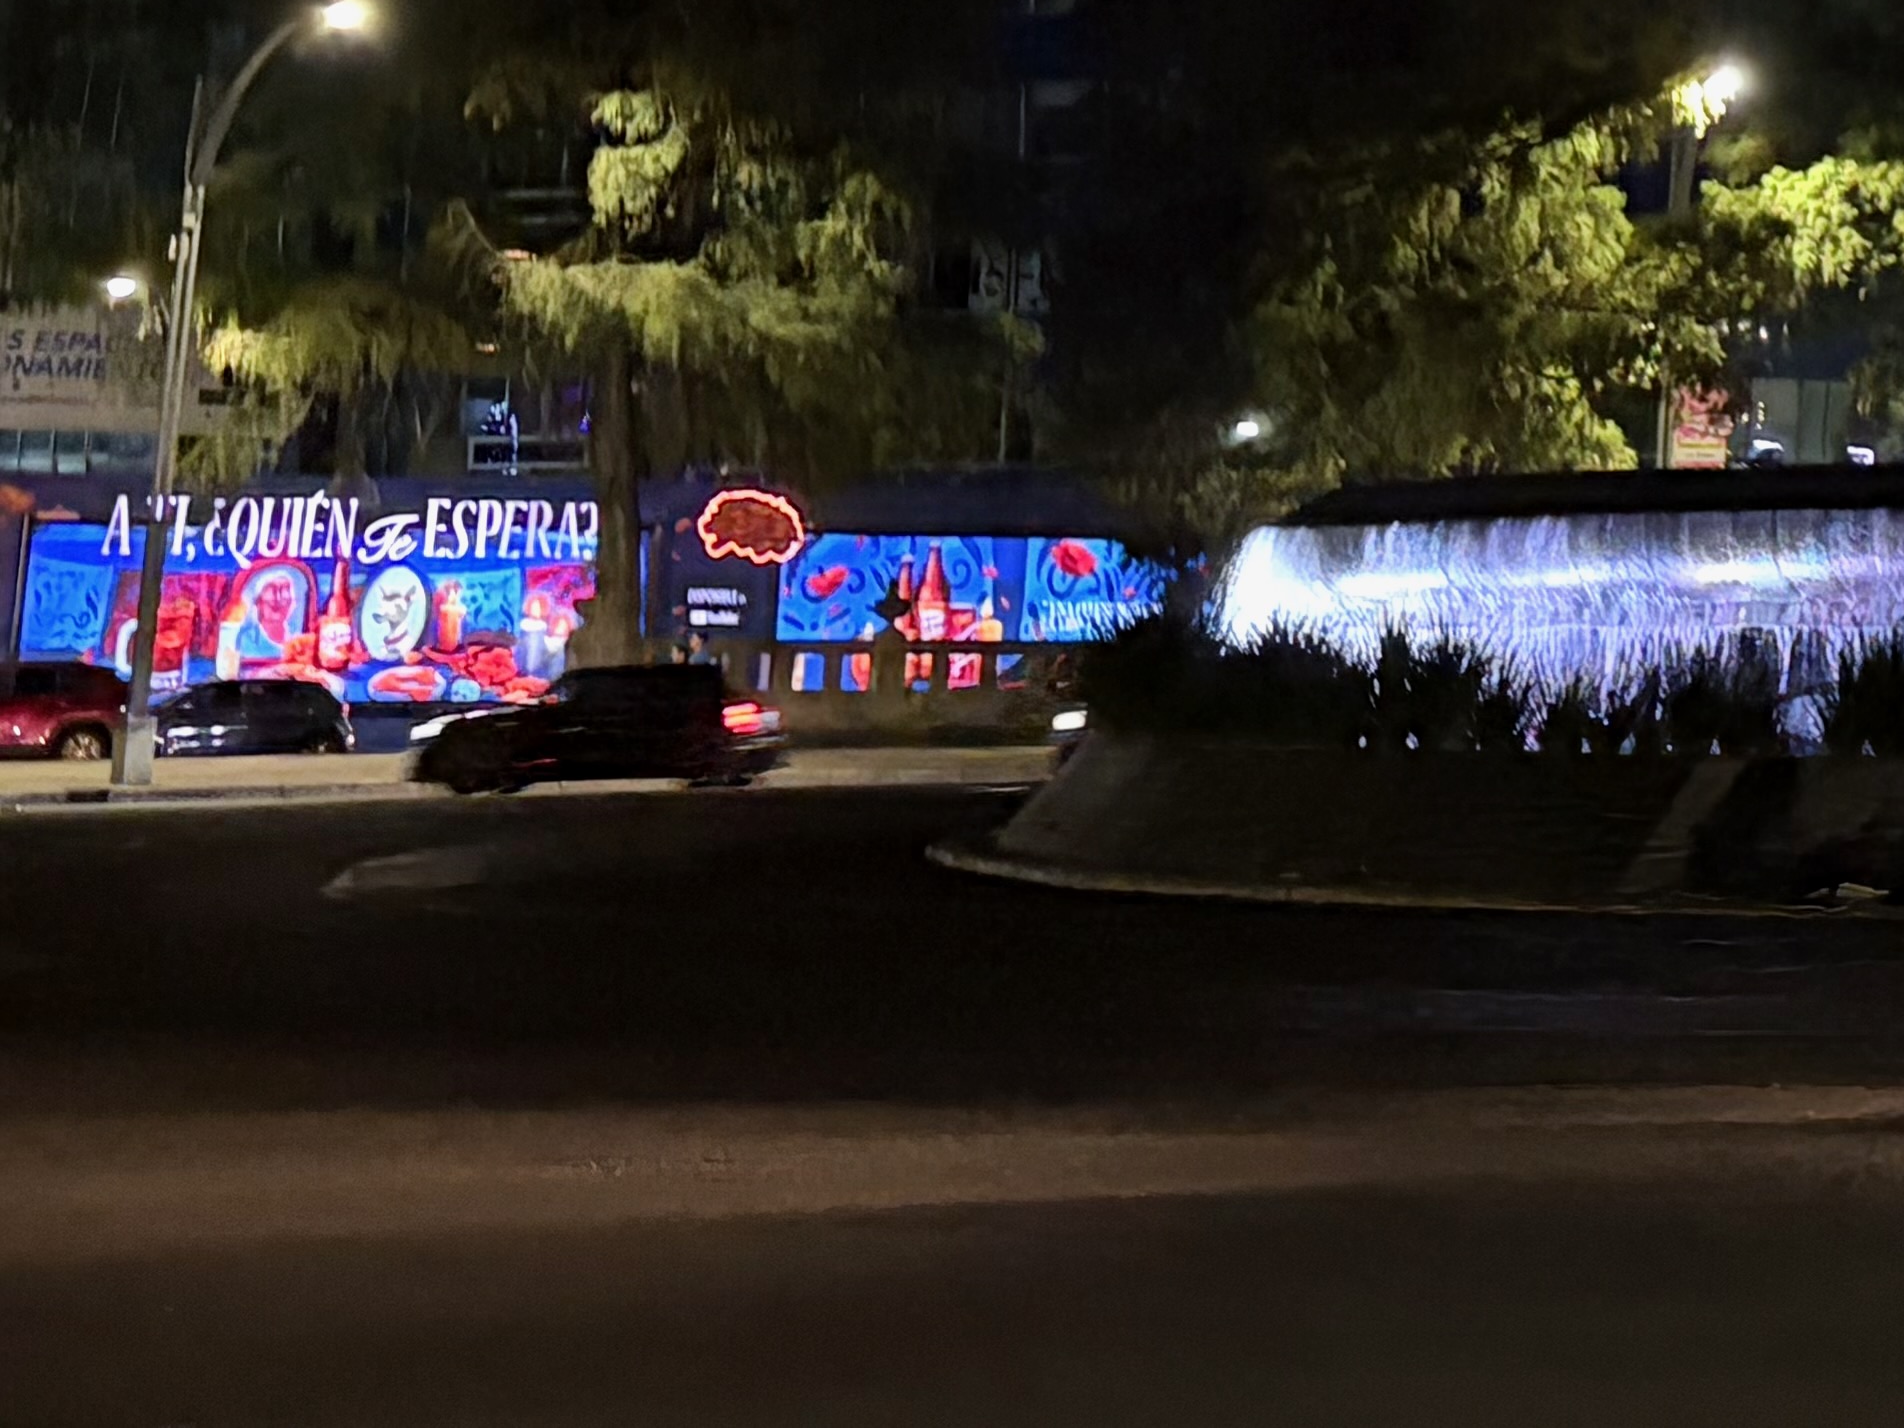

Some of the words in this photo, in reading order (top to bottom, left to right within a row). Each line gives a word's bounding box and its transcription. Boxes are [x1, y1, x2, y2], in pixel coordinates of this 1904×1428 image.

[101, 494, 131, 556] A
[203, 489, 359, 569] ¿QUIÉN
[357, 513, 420, 564] Te
[423, 498, 598, 561] ESPERA?
